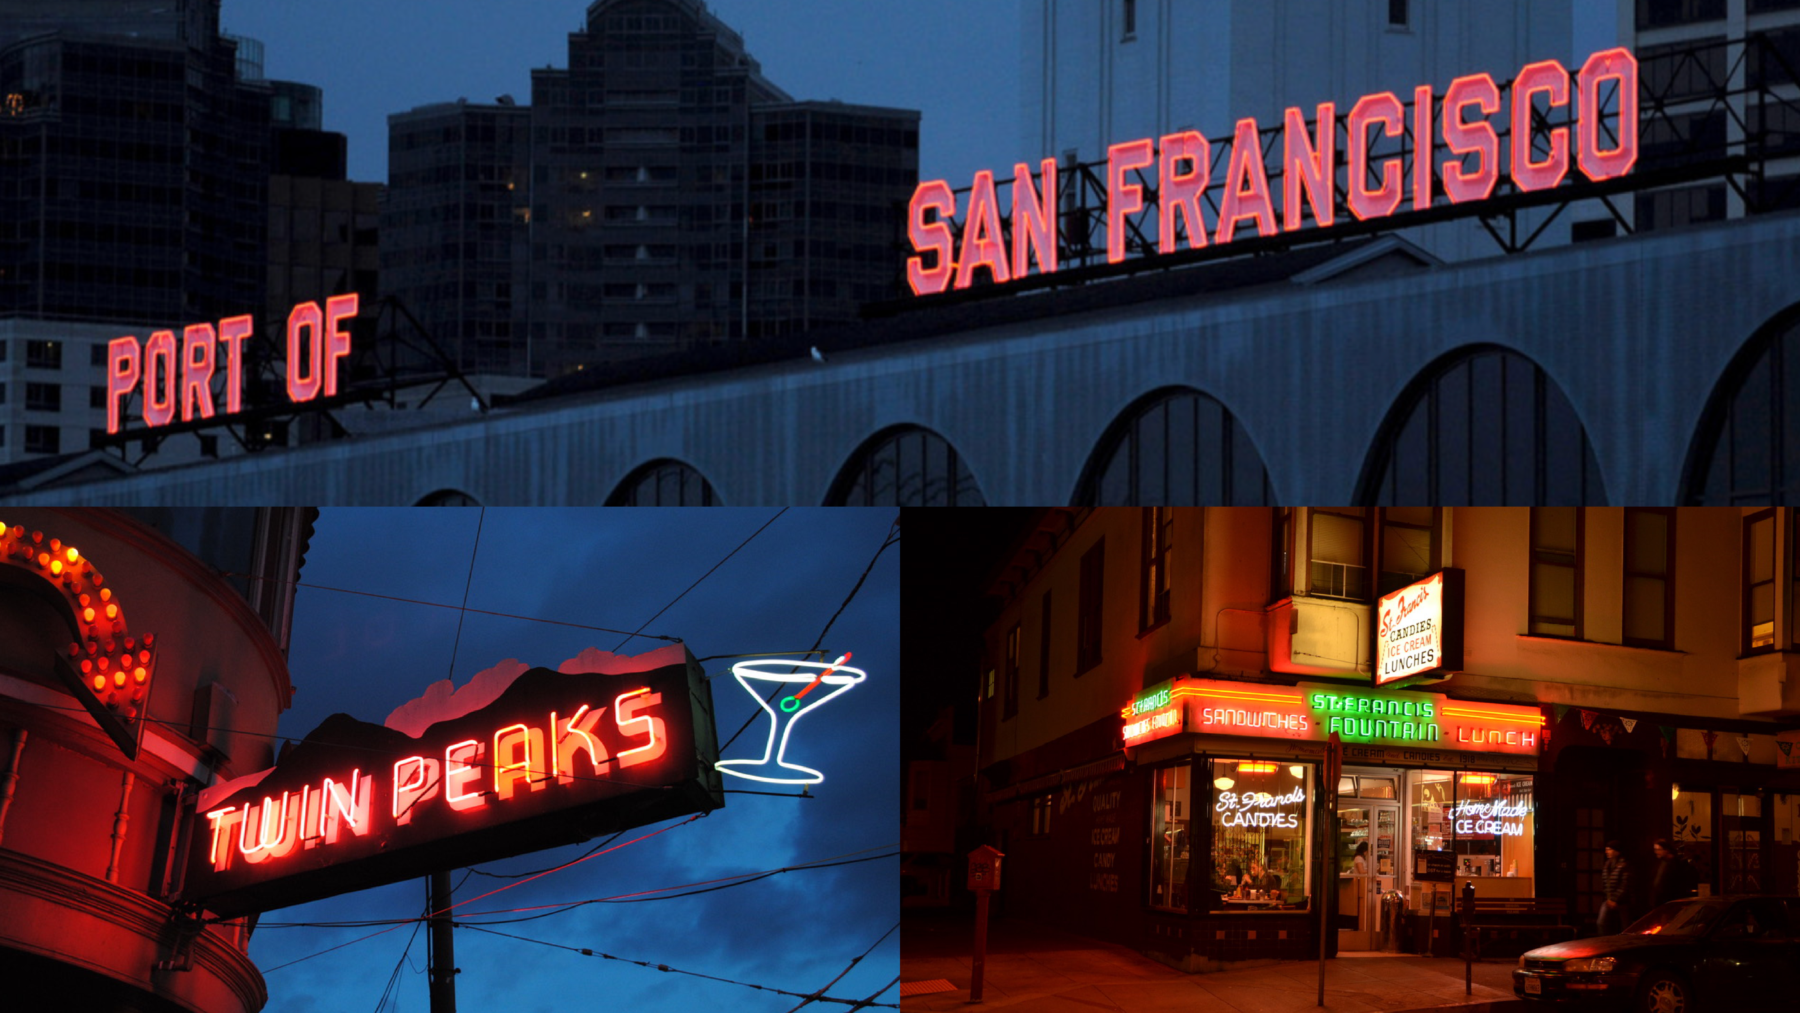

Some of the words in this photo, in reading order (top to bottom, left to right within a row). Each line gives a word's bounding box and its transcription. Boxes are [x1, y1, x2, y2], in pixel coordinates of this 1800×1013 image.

[906, 157, 1058, 296] SAN
[1106, 47, 1638, 264] FRANCISCO
[107, 314, 252, 434] PORT
[287, 293, 358, 402] OF
[1396, 586, 1429, 625] Francis
[1389, 618, 1432, 643] CANDIES
[1387, 644, 1401, 658] ICE
[1403, 634, 1432, 653] CREAM
[1385, 648, 1434, 675] LUNCHES
[1203, 708, 1308, 731] SANDWICHES
[1328, 716, 1439, 742] FOUNTAIN
[1457, 725, 1535, 747] LUNCH
[1286, 742, 1328, 755] Homemad
[1351, 747, 1385, 758] CREAM
[1403, 750, 1440, 761] CANDIES
[1459, 753, 1476, 764] 1918
[207, 768, 372, 873] TWIN
[392, 687, 668, 827] PEAKS
[1092, 790, 1122, 813] QUALITY
[1215, 791, 1240, 811] St.
[1239, 785, 1305, 811] Francis
[1222, 812, 1298, 828] CANDIES
[1455, 820, 1473, 834] CE
[1475, 820, 1524, 836] CREAM
[1090, 827, 1100, 846] ICE
[1100, 827, 1121, 846] CREAM
[1093, 852, 1116, 869] CANDY
[1089, 872, 1119, 893] LUNCHES
